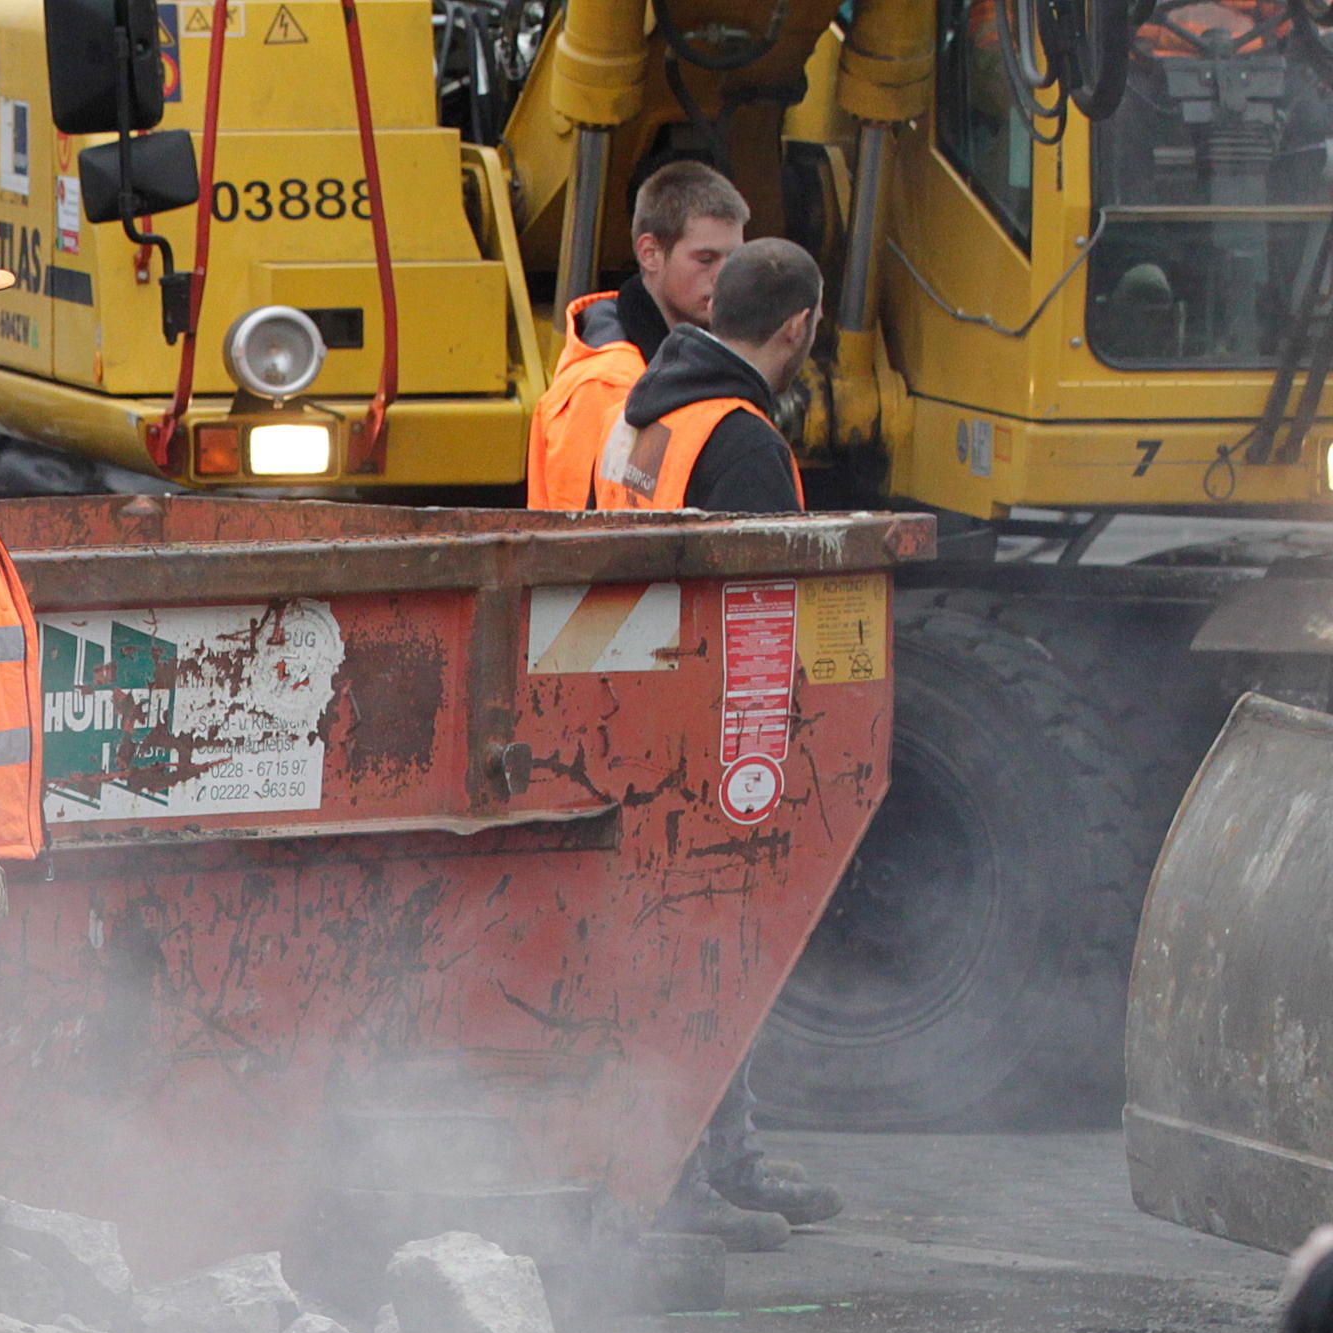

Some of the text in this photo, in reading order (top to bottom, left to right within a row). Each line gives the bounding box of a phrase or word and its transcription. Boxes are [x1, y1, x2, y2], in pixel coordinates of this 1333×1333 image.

[212, 178, 373, 222] 03888
[1132, 439, 1163, 477] 7
[211, 763, 244, 778] 0228
[210, 784, 250, 800] 02222
